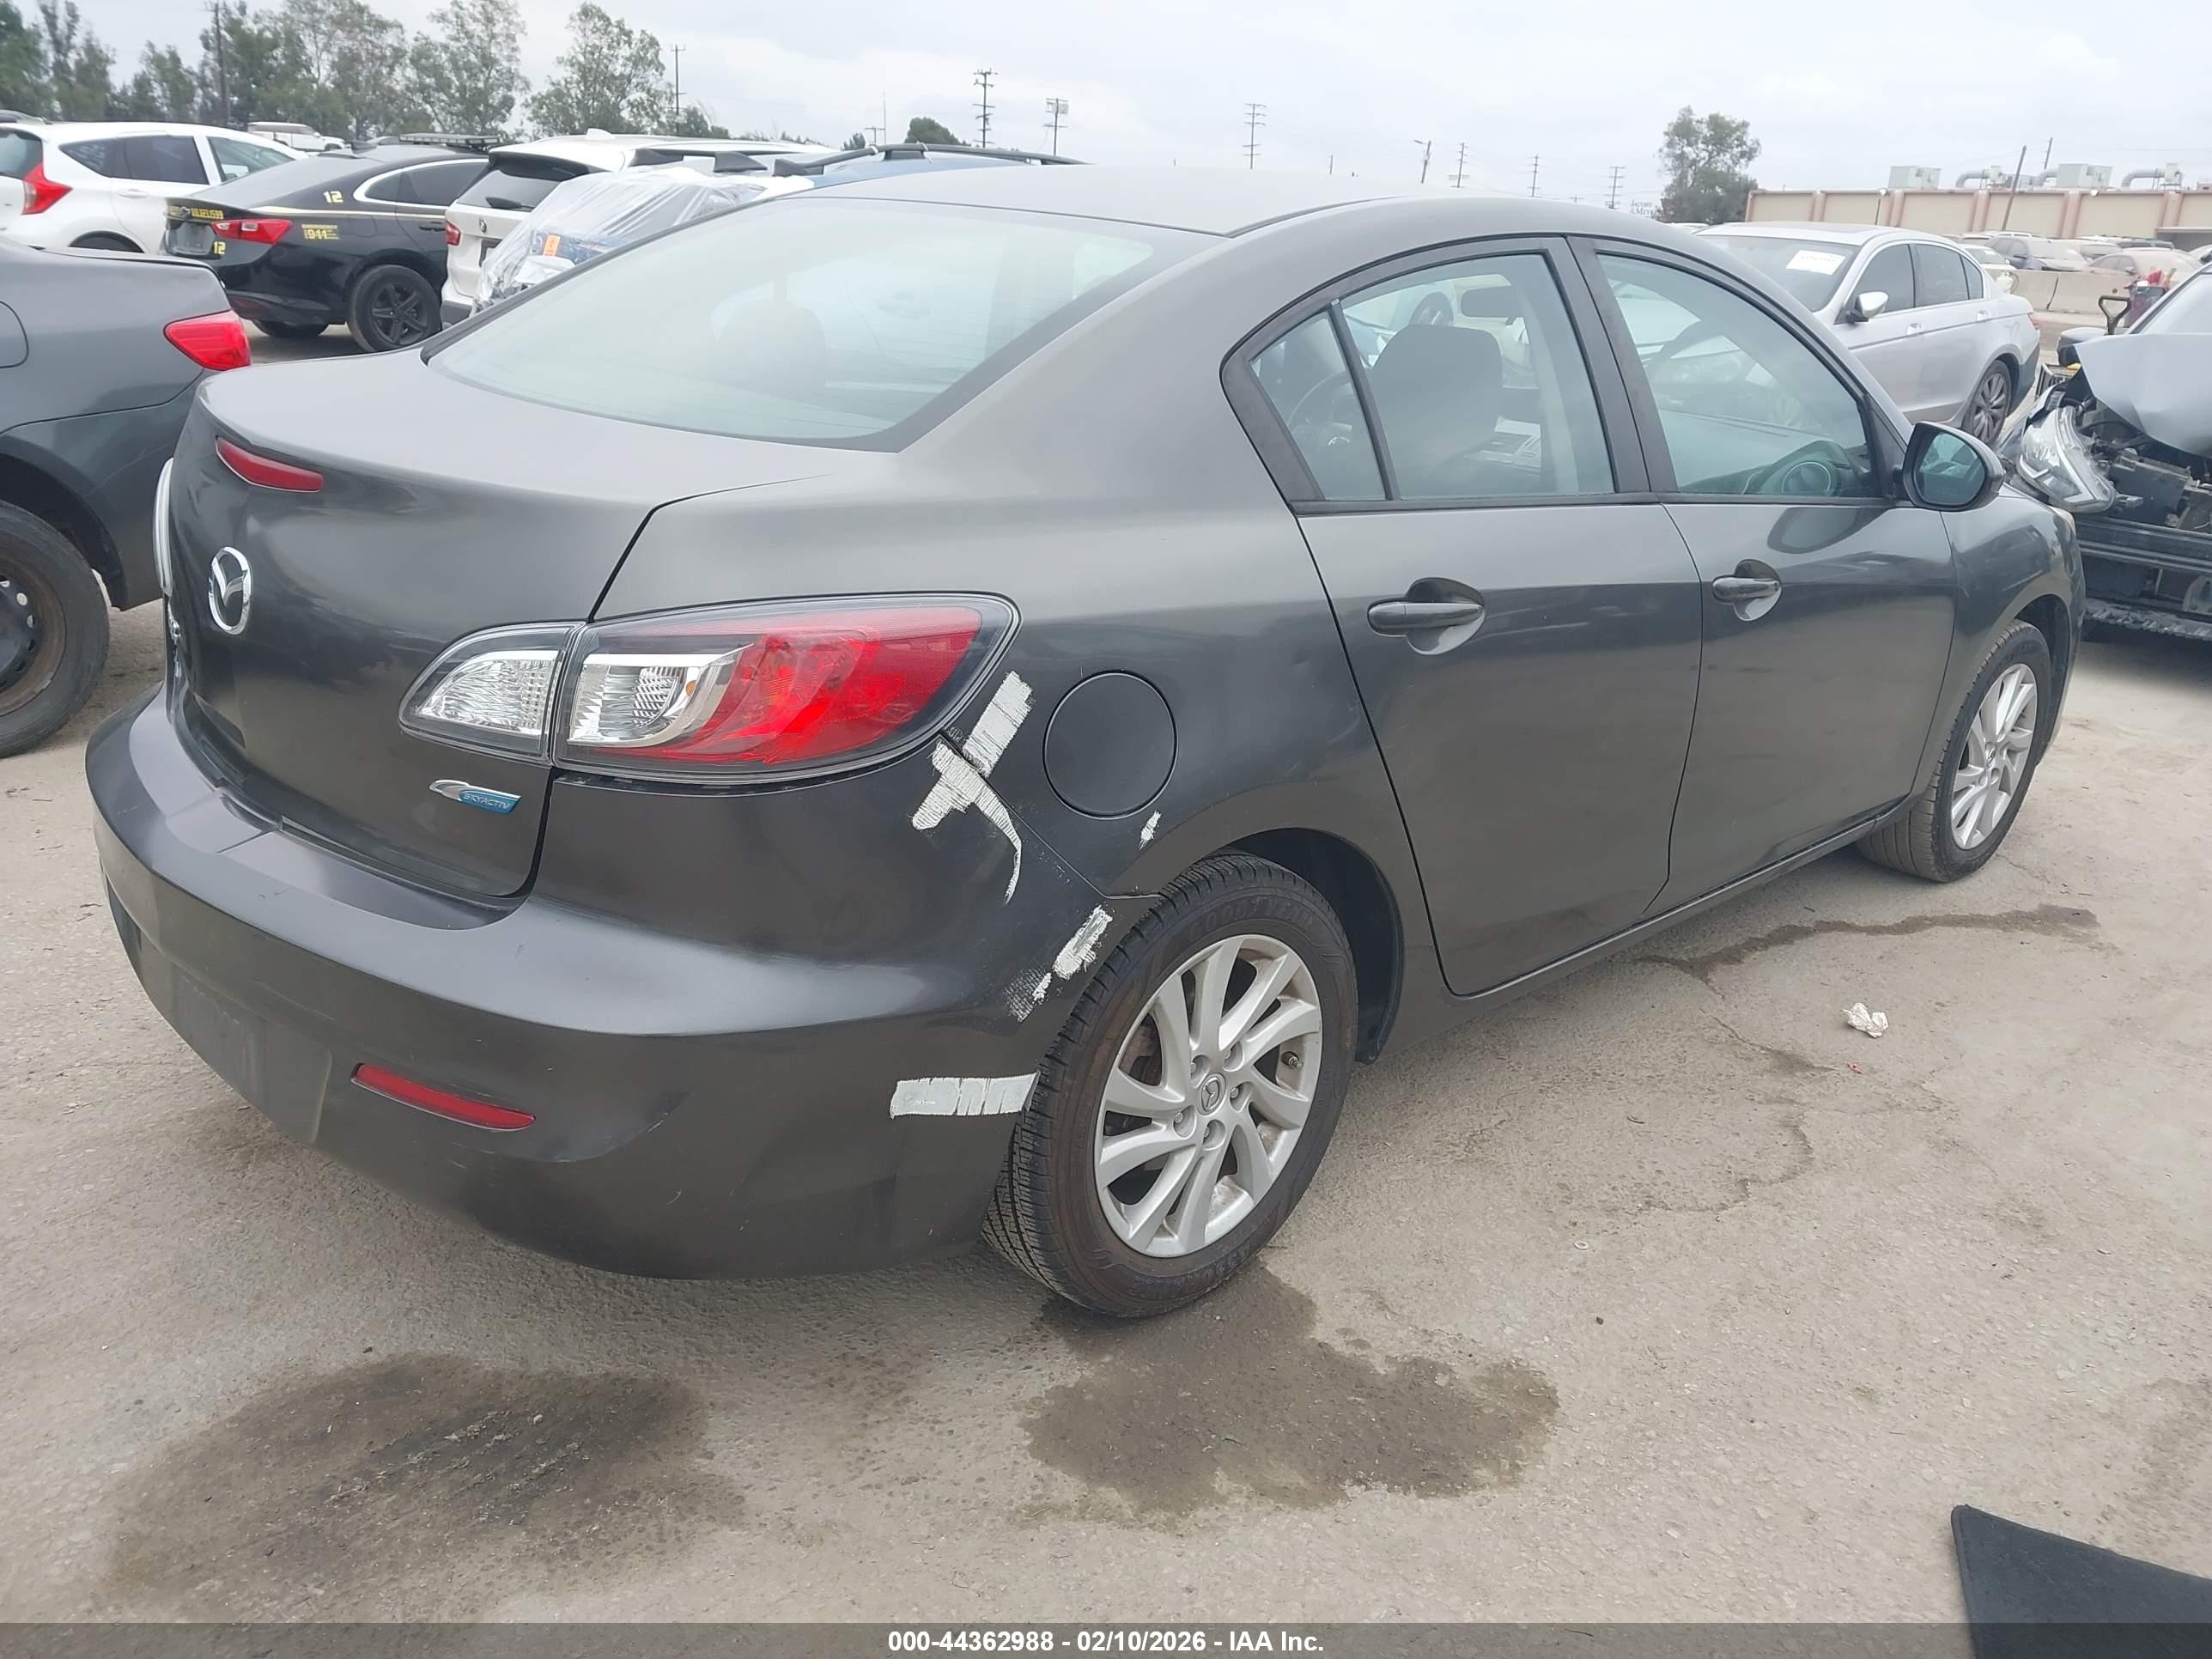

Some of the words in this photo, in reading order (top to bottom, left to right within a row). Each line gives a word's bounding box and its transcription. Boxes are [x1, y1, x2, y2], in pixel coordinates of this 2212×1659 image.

[323, 191, 343, 203] 12
[307, 228, 328, 240] 911
[214, 241, 226, 254] 12
[463, 793, 511, 809] SKYACTIV
